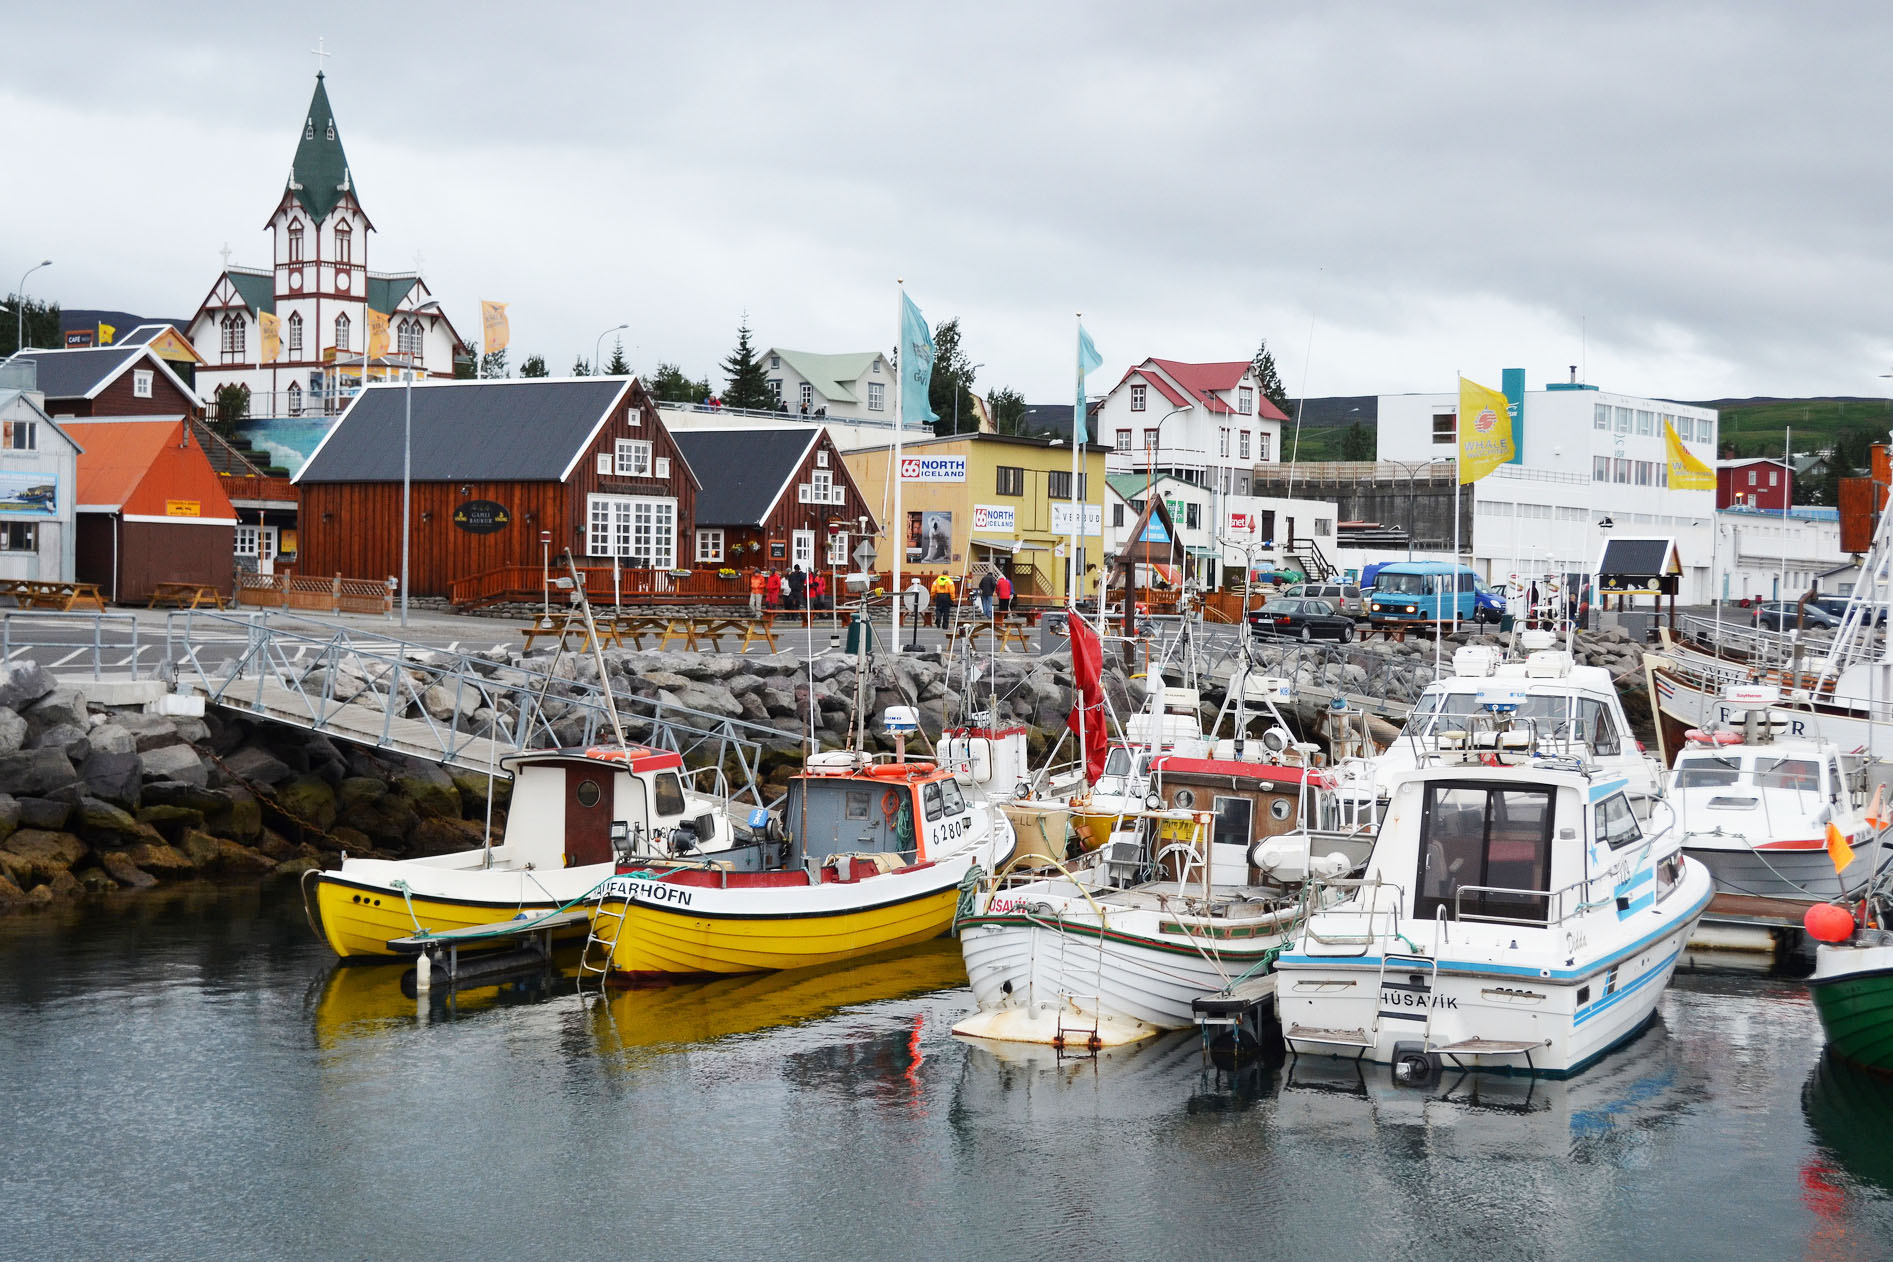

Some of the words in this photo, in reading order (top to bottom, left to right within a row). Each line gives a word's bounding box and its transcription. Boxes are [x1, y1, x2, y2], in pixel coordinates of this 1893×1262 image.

[1464, 438, 1508, 451] WHALE
[921, 460, 965, 470] NORTH
[987, 510, 1014, 520] NORTH
[933, 821, 962, 845] 6280
